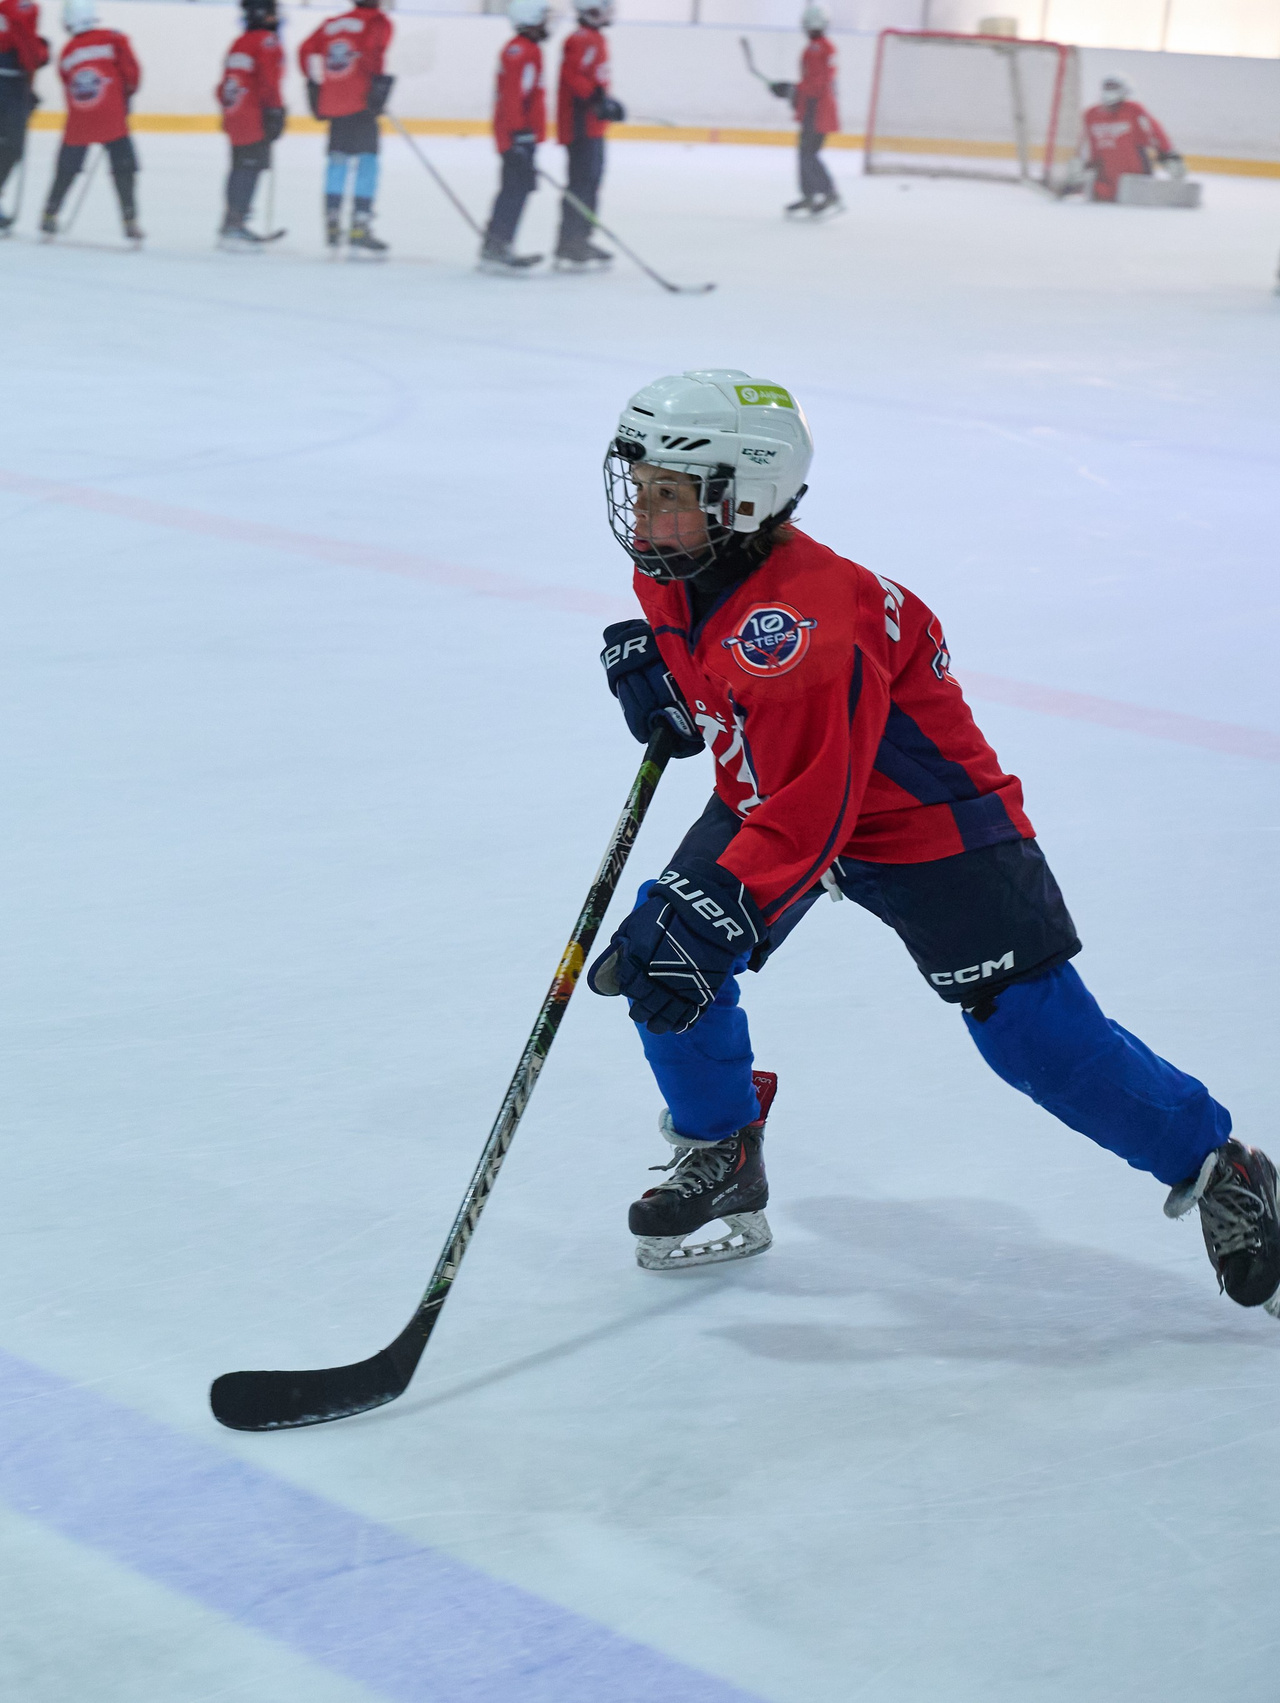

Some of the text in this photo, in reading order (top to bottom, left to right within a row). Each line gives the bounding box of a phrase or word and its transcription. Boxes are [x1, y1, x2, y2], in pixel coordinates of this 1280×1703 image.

[618, 424, 647, 441] CCM
[741, 447, 777, 458] CCM
[750, 613, 785, 637] 10
[744, 630, 797, 653] STEPS
[656, 870, 745, 942] AUER
[929, 950, 1015, 986] CCM
